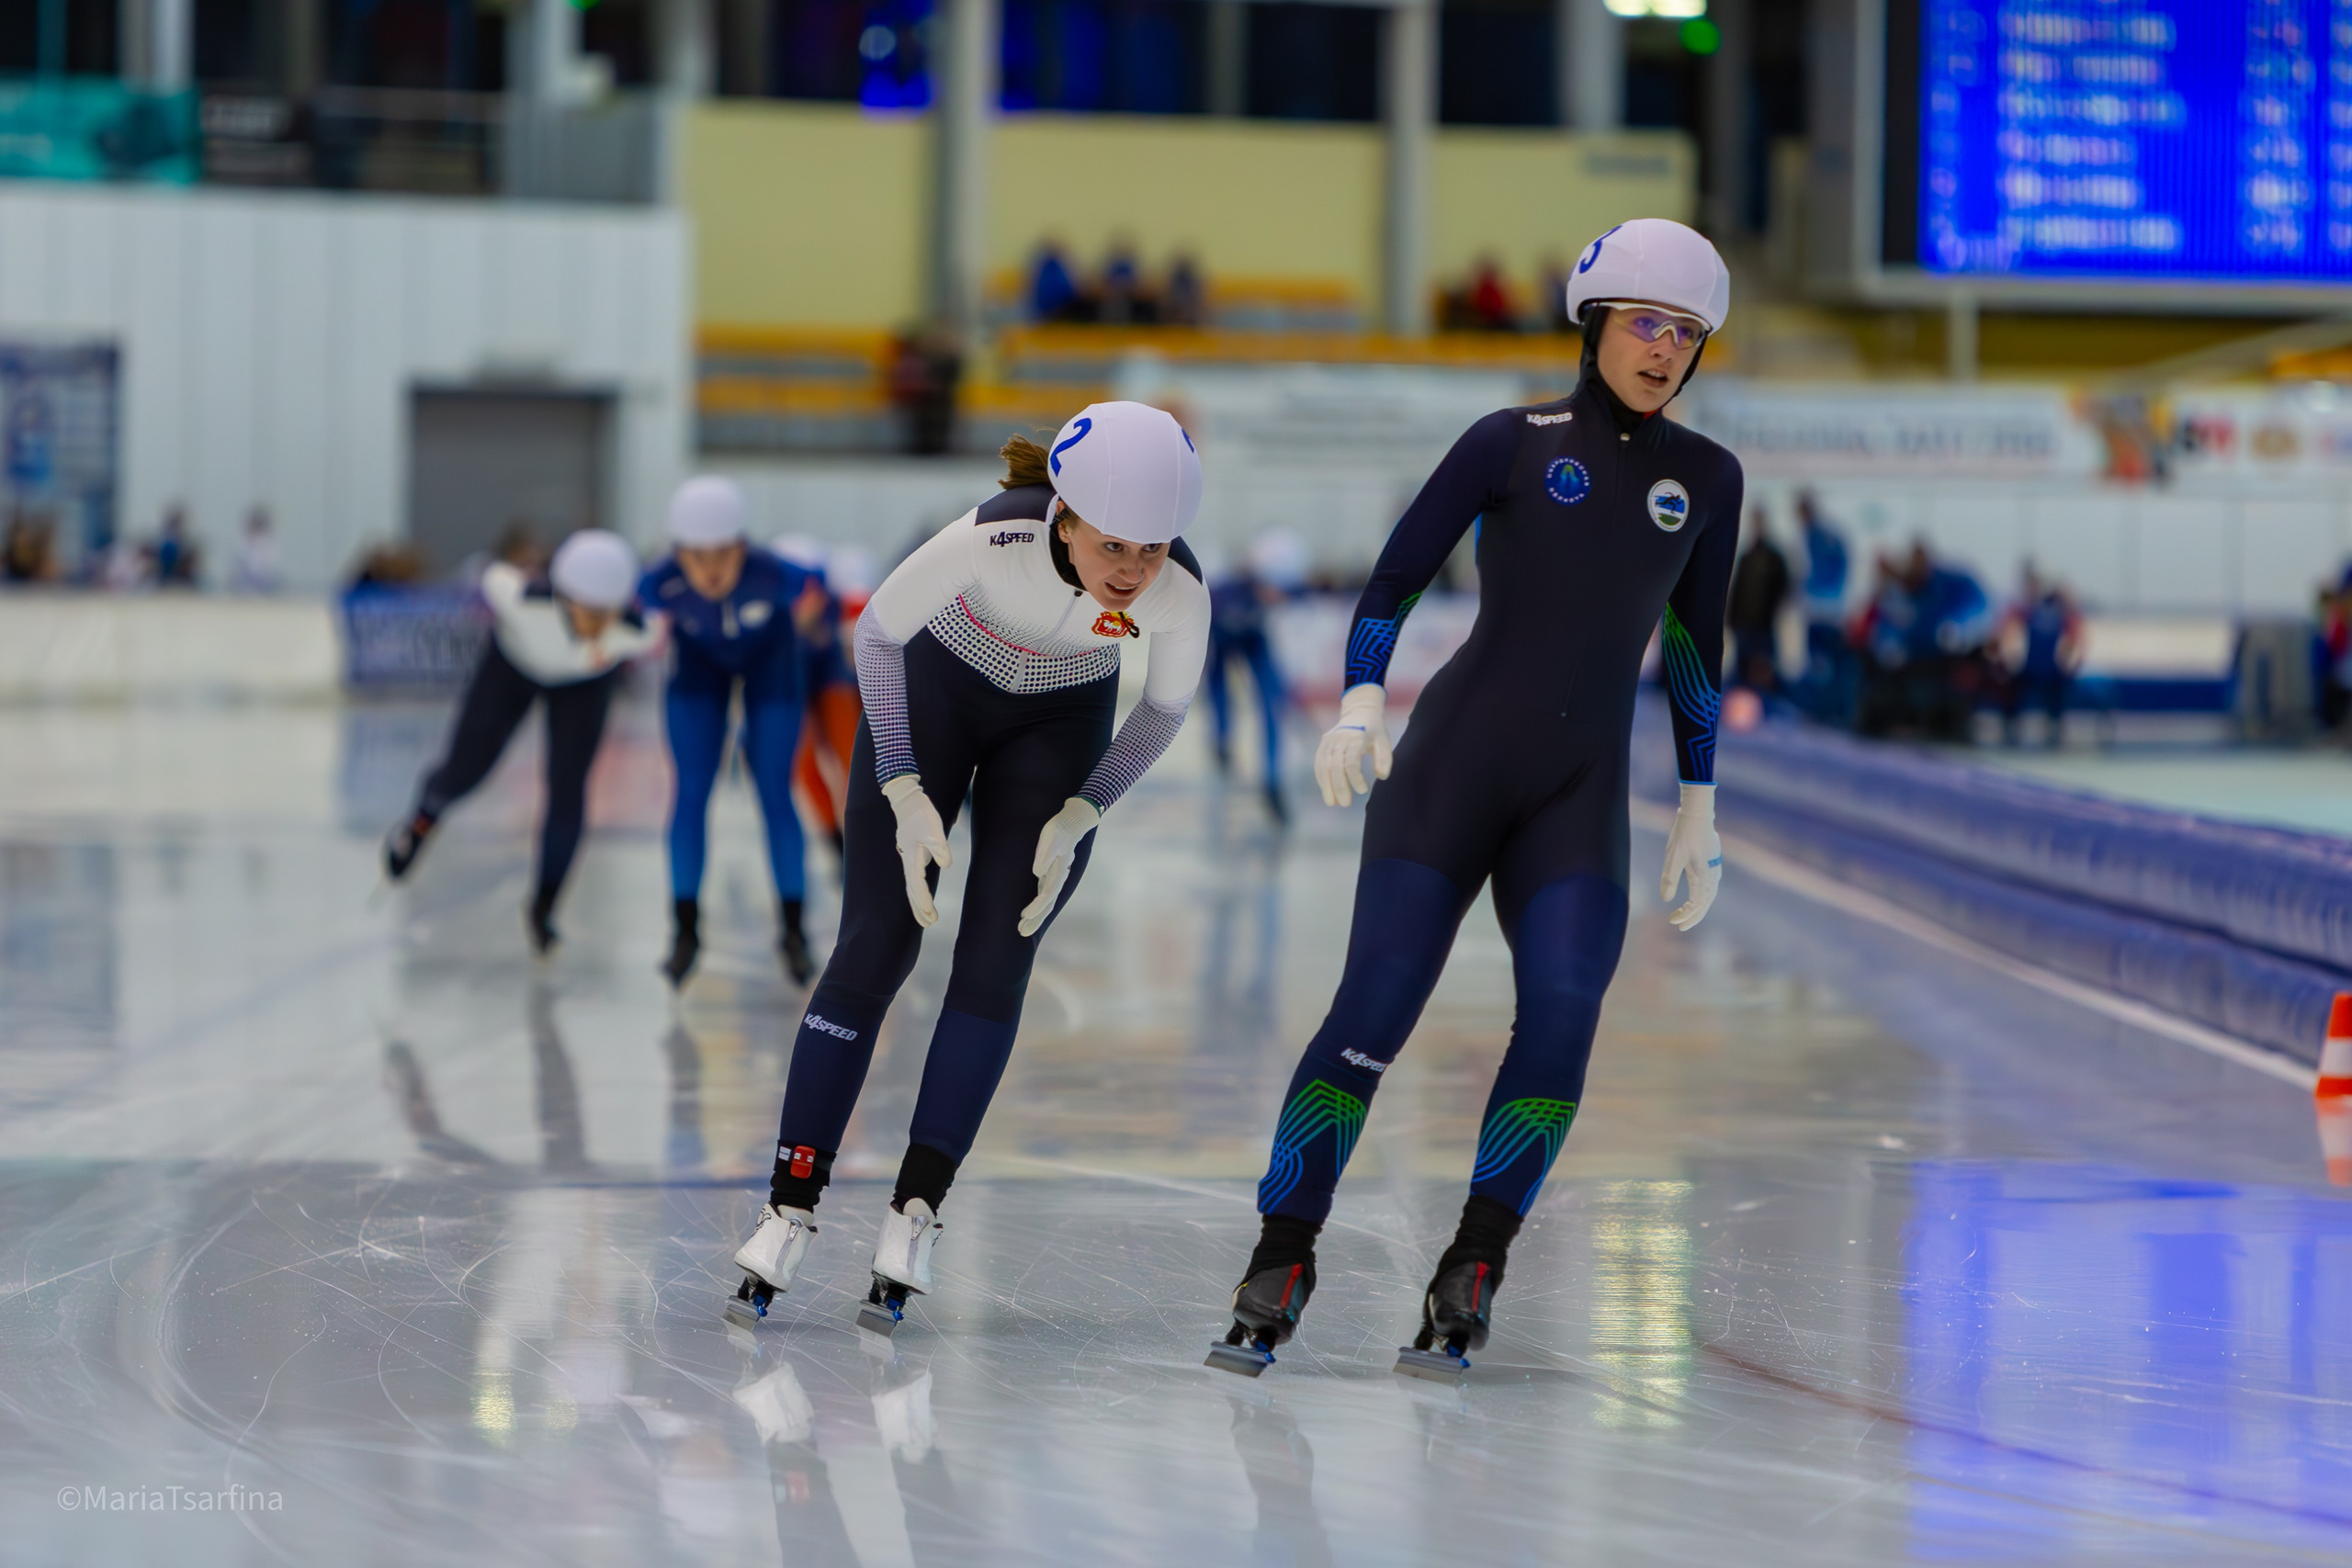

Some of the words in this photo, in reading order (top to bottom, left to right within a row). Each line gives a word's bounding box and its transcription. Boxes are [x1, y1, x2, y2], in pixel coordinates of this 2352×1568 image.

[1049, 417, 1092, 478] 2
[989, 531, 1035, 547] K4SPEED
[804, 1013, 858, 1041] K4SPEED
